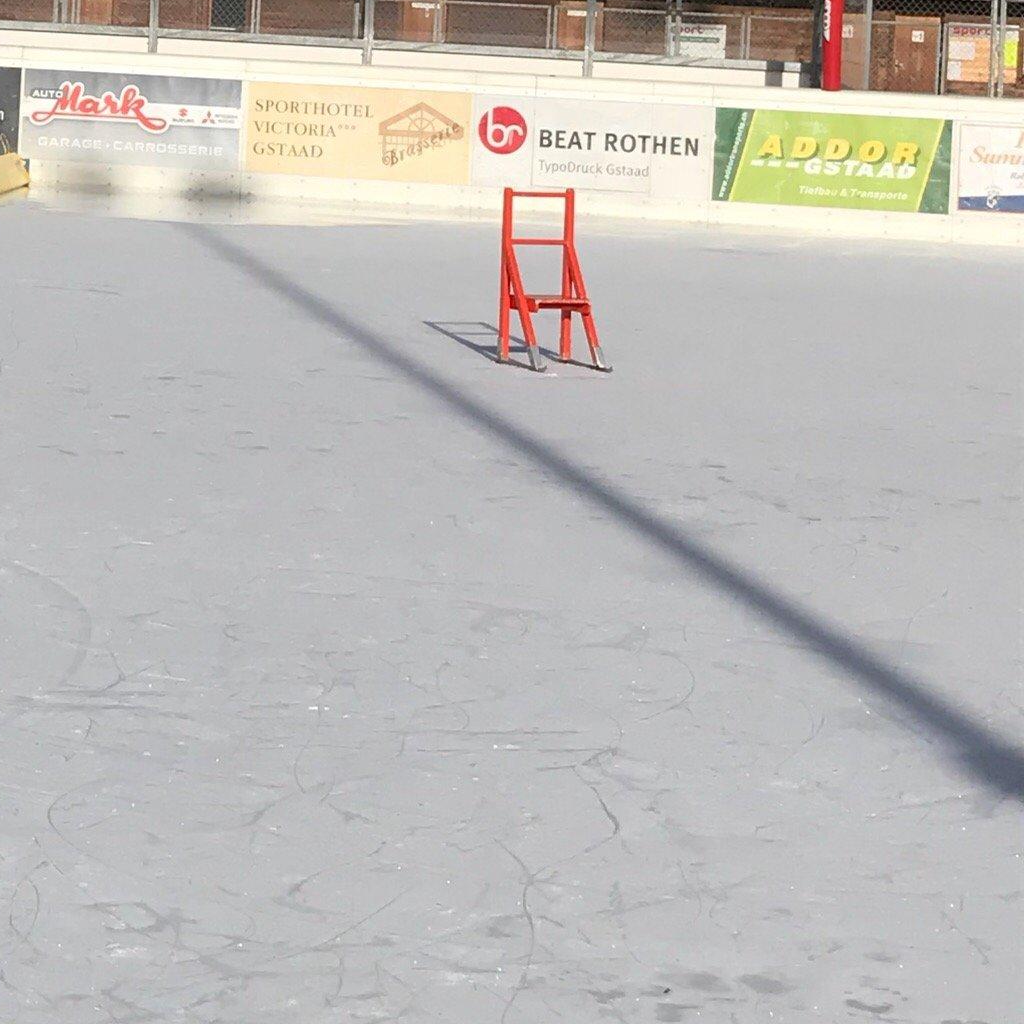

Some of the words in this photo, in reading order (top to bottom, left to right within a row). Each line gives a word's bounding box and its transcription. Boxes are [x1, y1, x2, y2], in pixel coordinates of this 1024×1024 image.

[32, 89, 63, 98] AUTO
[31, 83, 167, 131] Mark
[255, 99, 374, 118] SPORTHOTEL
[254, 120, 337, 137] VICTORIA
[38, 136, 102, 150] GARAGE
[112, 141, 224, 156] CARROSSERIE
[252, 142, 323, 158] GSTAAD
[539, 129, 596, 150] BEAT
[604, 132, 699, 156] ROTHEN
[757, 134, 922, 165] ADDOR
[538, 159, 602, 176] TypoDruck
[606, 163, 650, 177] Gstaad
[803, 158, 917, 180] GSTAAD
[799, 185, 836, 197] Tiefbau
[840, 188, 847, 197] &
[850, 189, 908, 201] Transporte
